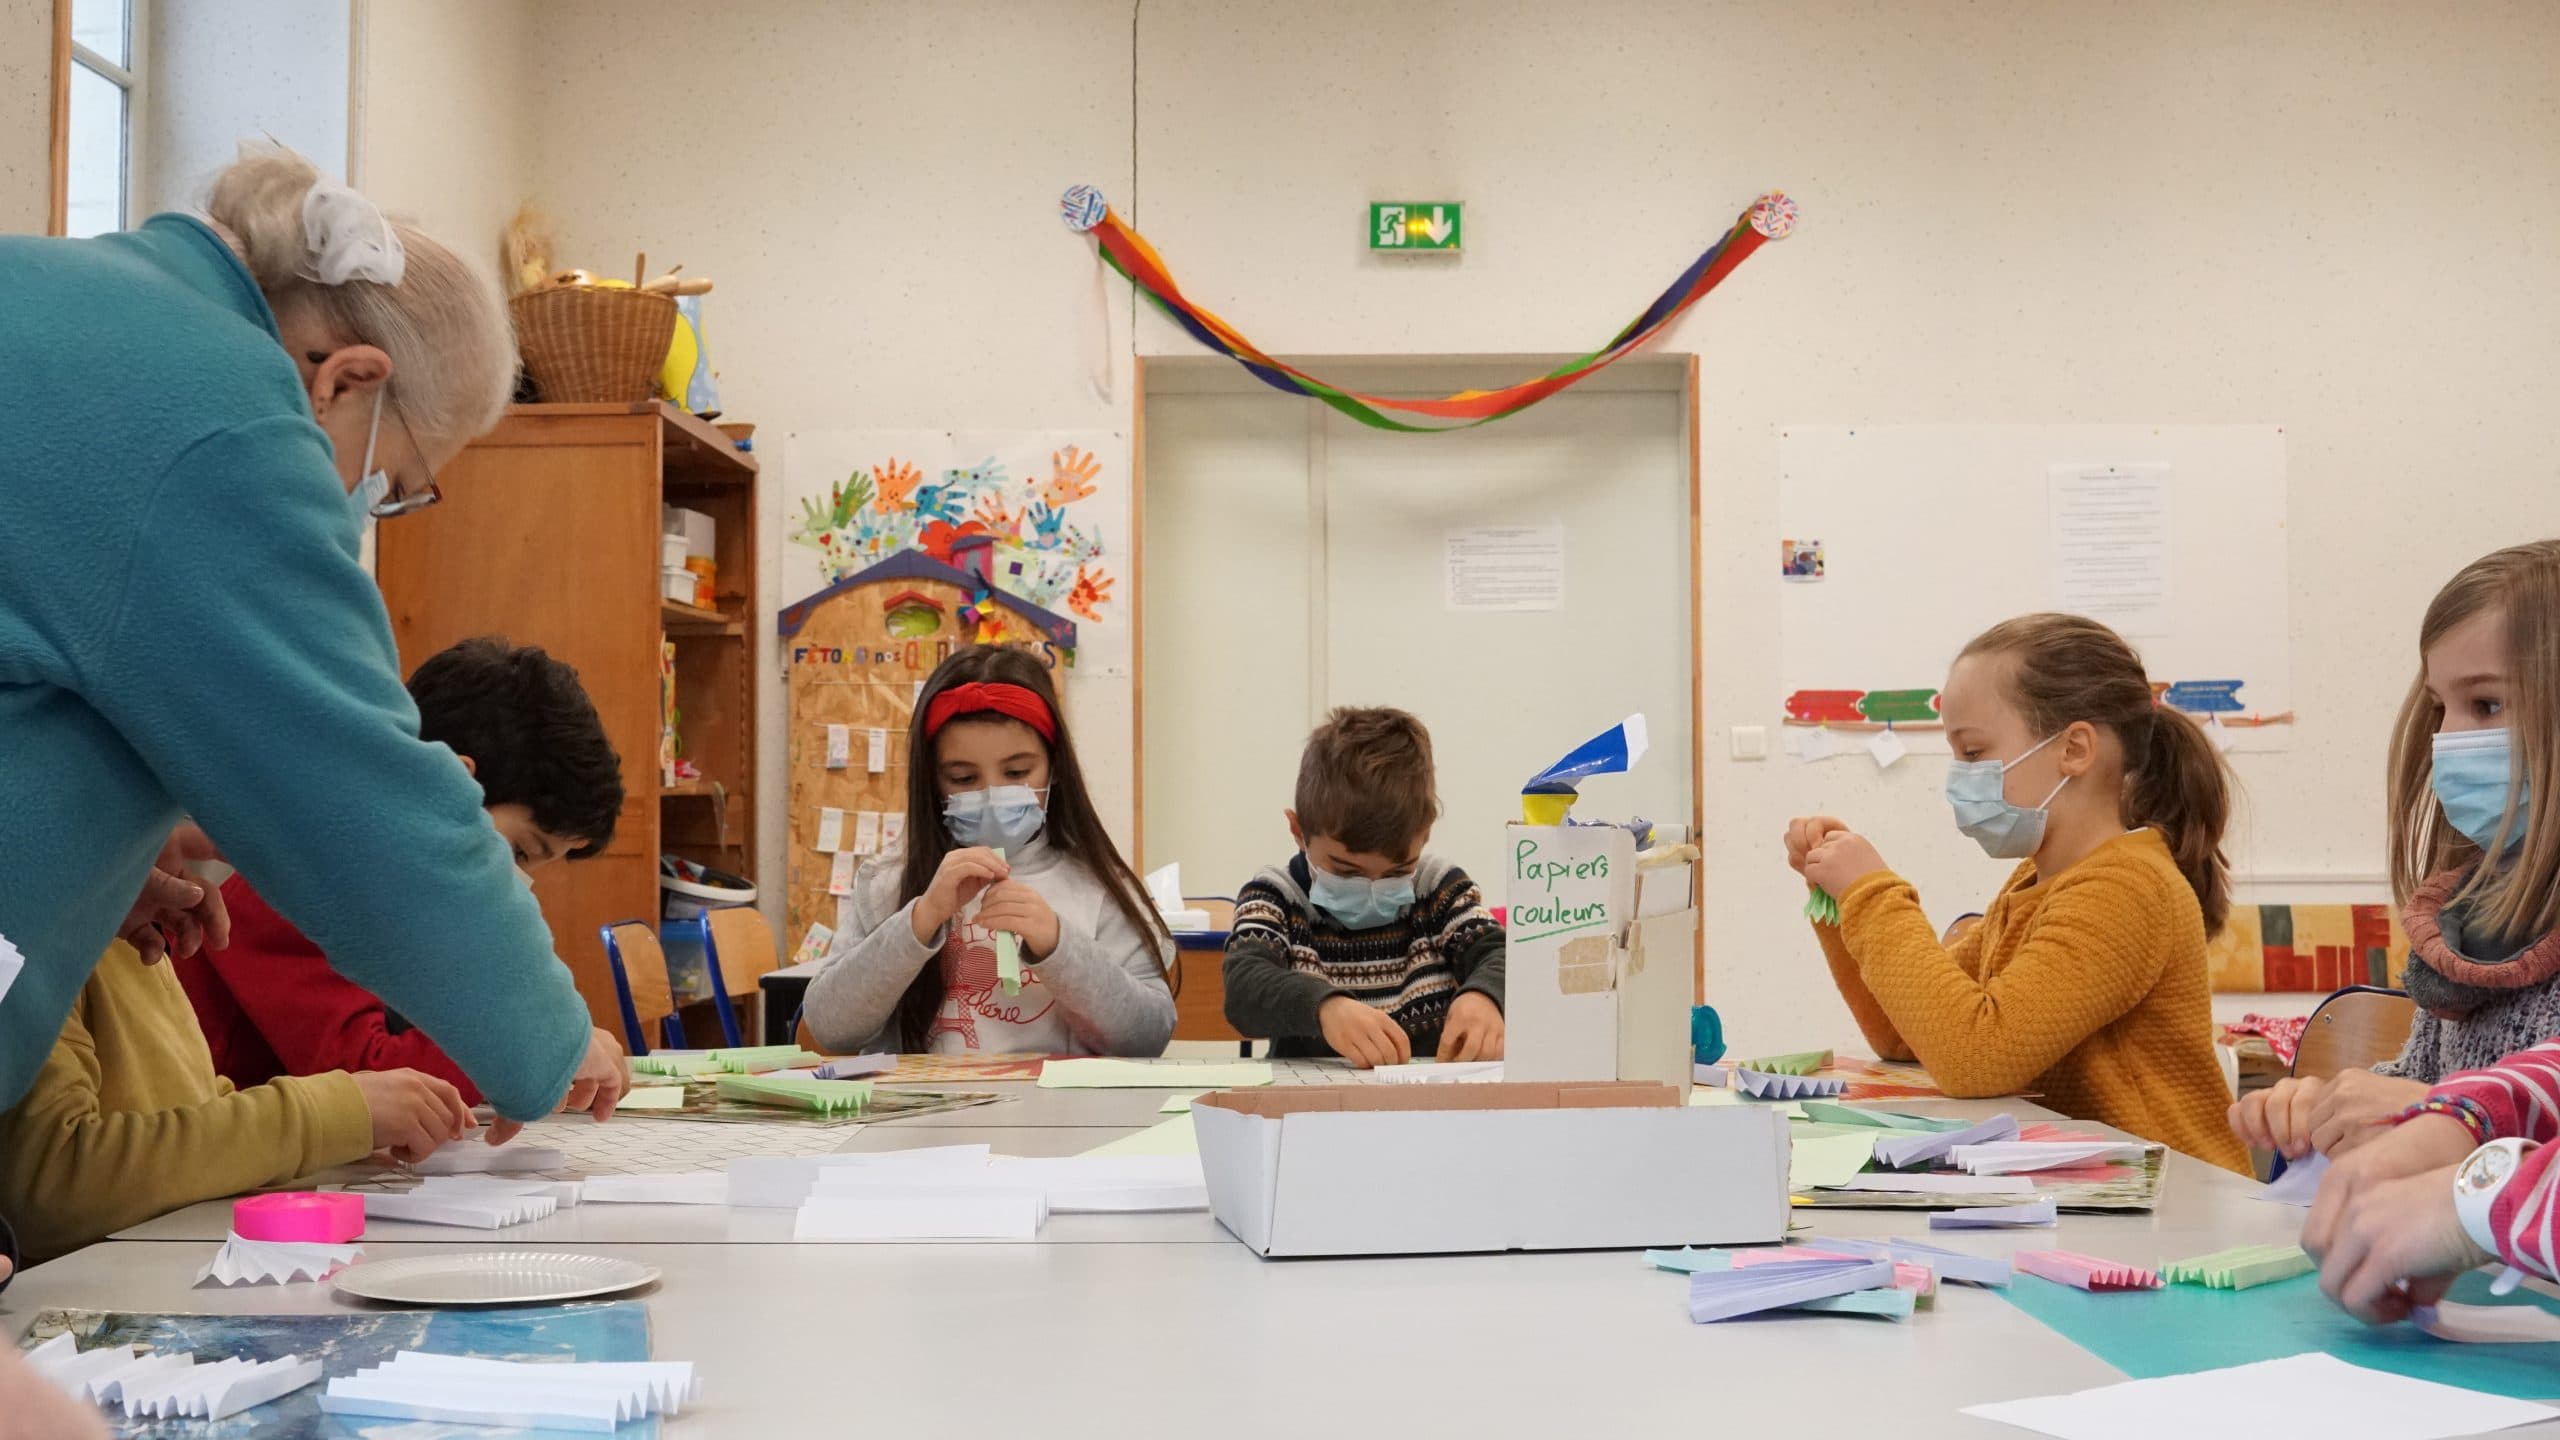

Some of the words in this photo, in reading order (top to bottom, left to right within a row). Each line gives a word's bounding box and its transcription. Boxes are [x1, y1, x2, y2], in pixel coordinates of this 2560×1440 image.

[1516, 839, 1609, 893] Papiers
[1512, 896, 1606, 927] couleurs
[966, 987, 1056, 1025] chérie
